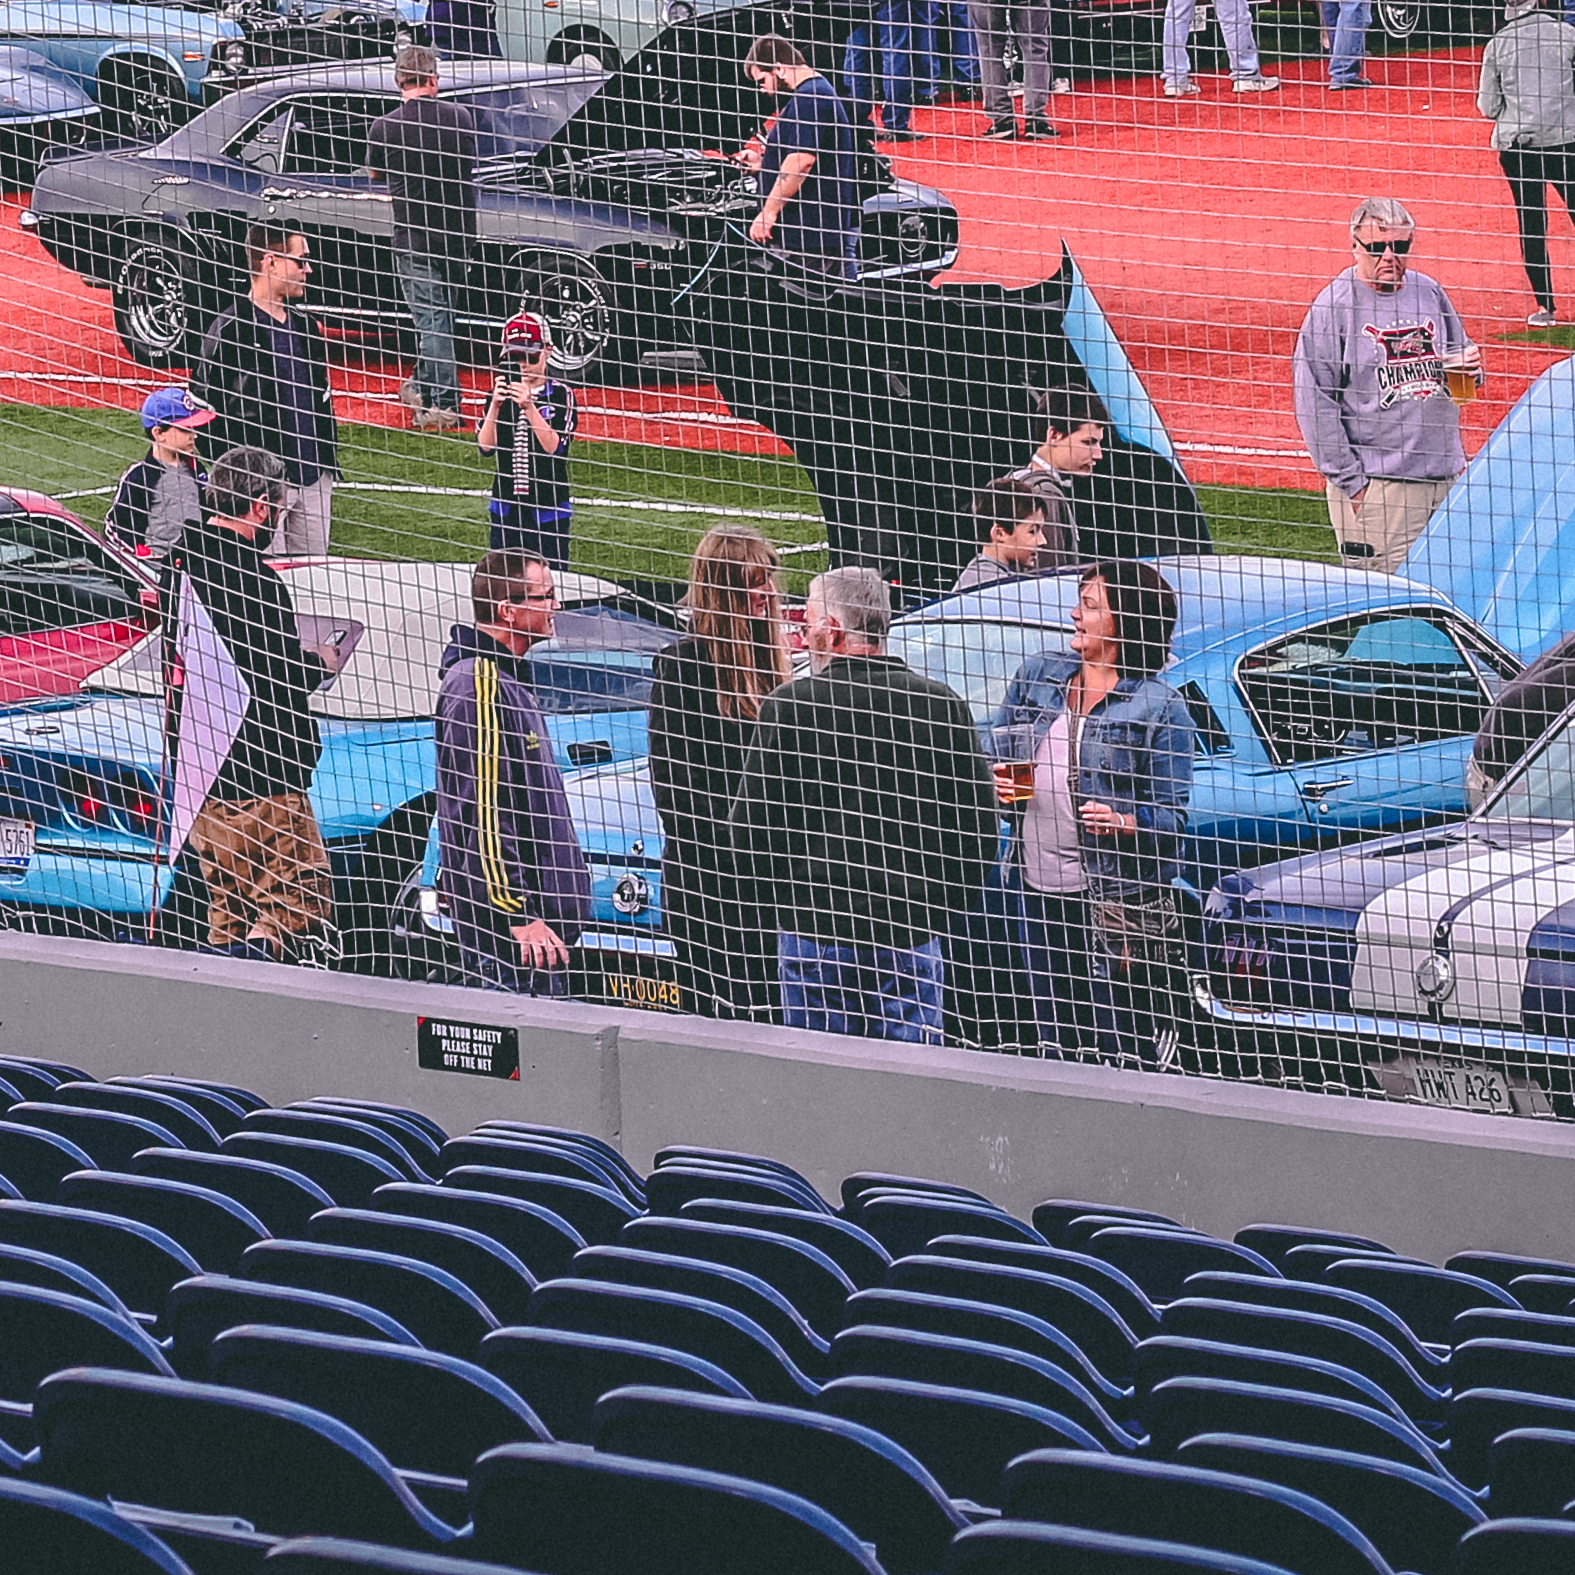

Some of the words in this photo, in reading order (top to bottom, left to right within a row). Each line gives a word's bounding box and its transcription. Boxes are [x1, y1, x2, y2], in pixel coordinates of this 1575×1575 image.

[431, 1022, 448, 1037] FOR
[448, 1024, 472, 1040] YOUR
[472, 1028, 502, 1044] SAFETY
[441, 1038, 472, 1054] PLEASE
[472, 1042, 494, 1057] STAY
[443, 1053, 459, 1067] OFF
[460, 1055, 476, 1070] THE
[476, 1057, 492, 1072] NET
